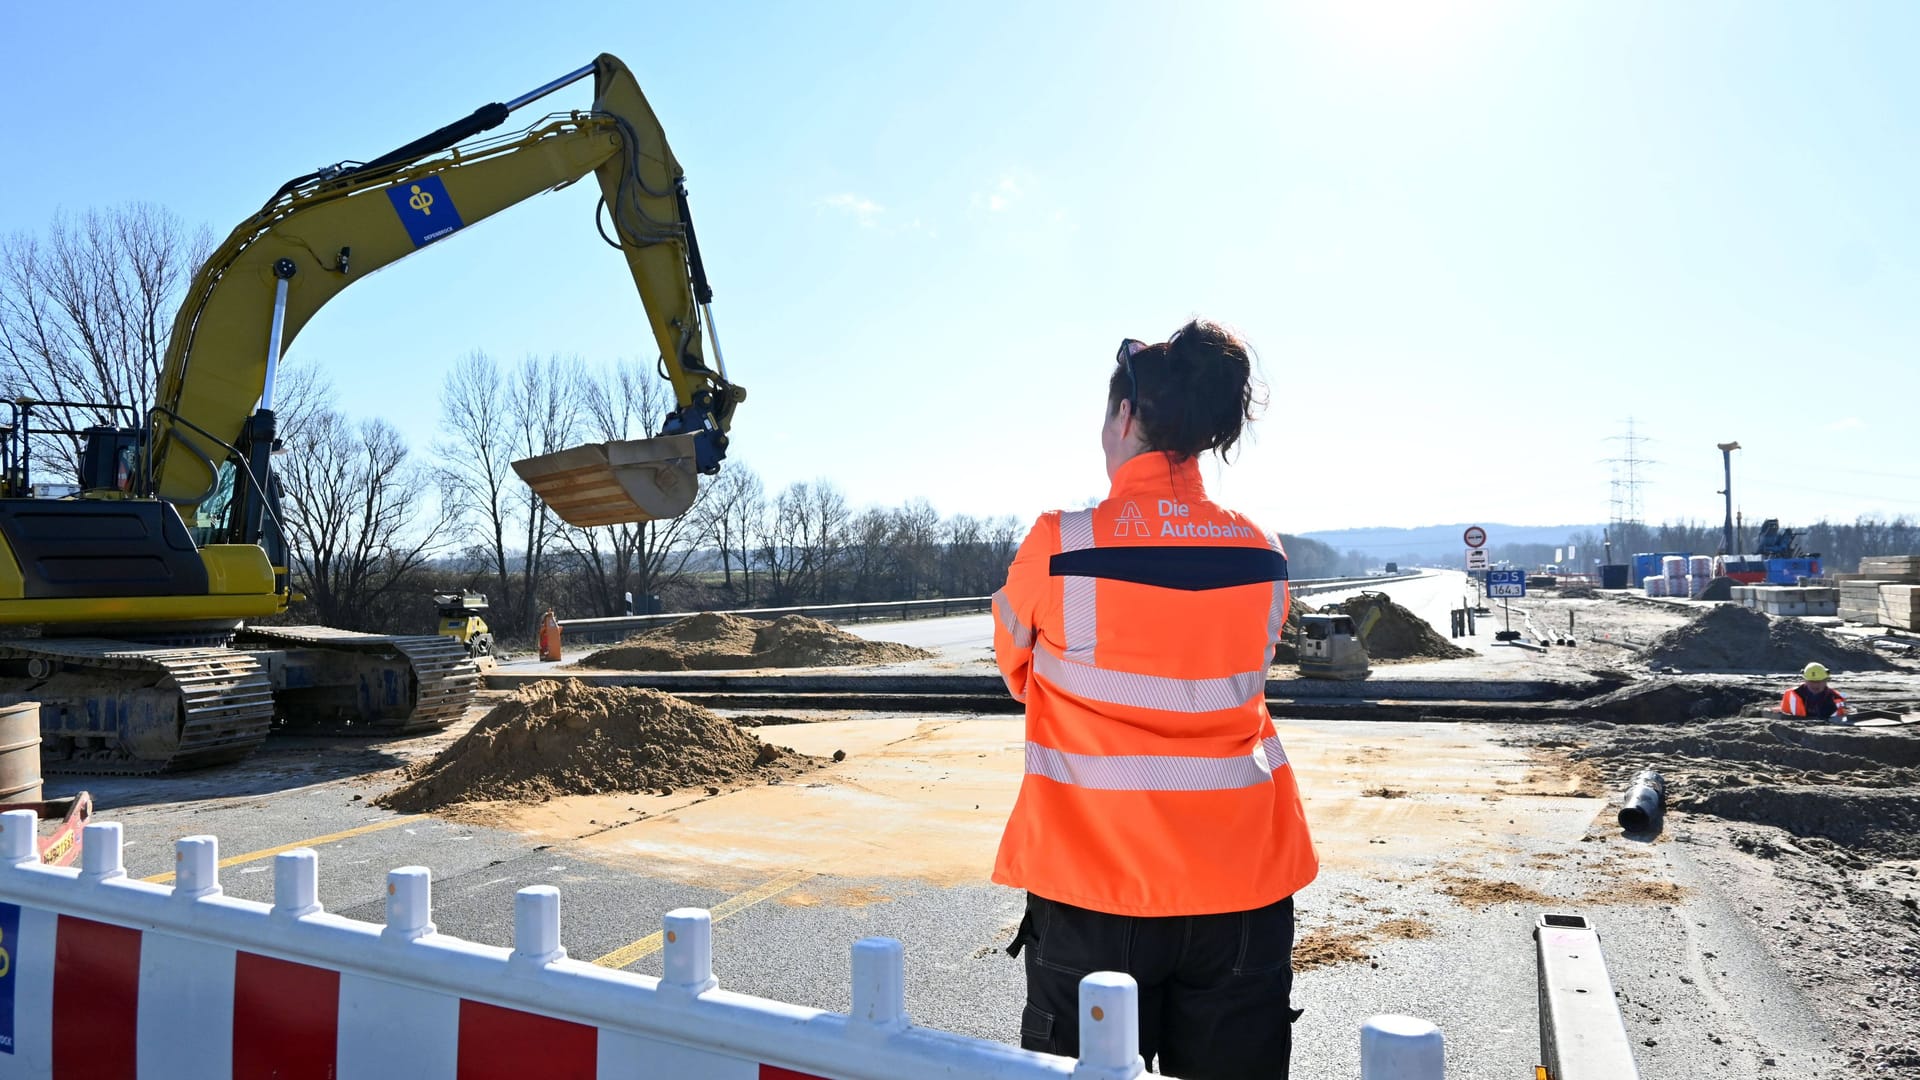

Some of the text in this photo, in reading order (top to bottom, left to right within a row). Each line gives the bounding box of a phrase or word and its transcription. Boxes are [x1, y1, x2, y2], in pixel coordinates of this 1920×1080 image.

[1158, 499, 1189, 517] Die
[1160, 520, 1256, 538] Autobahn
[1511, 572, 1519, 581] S
